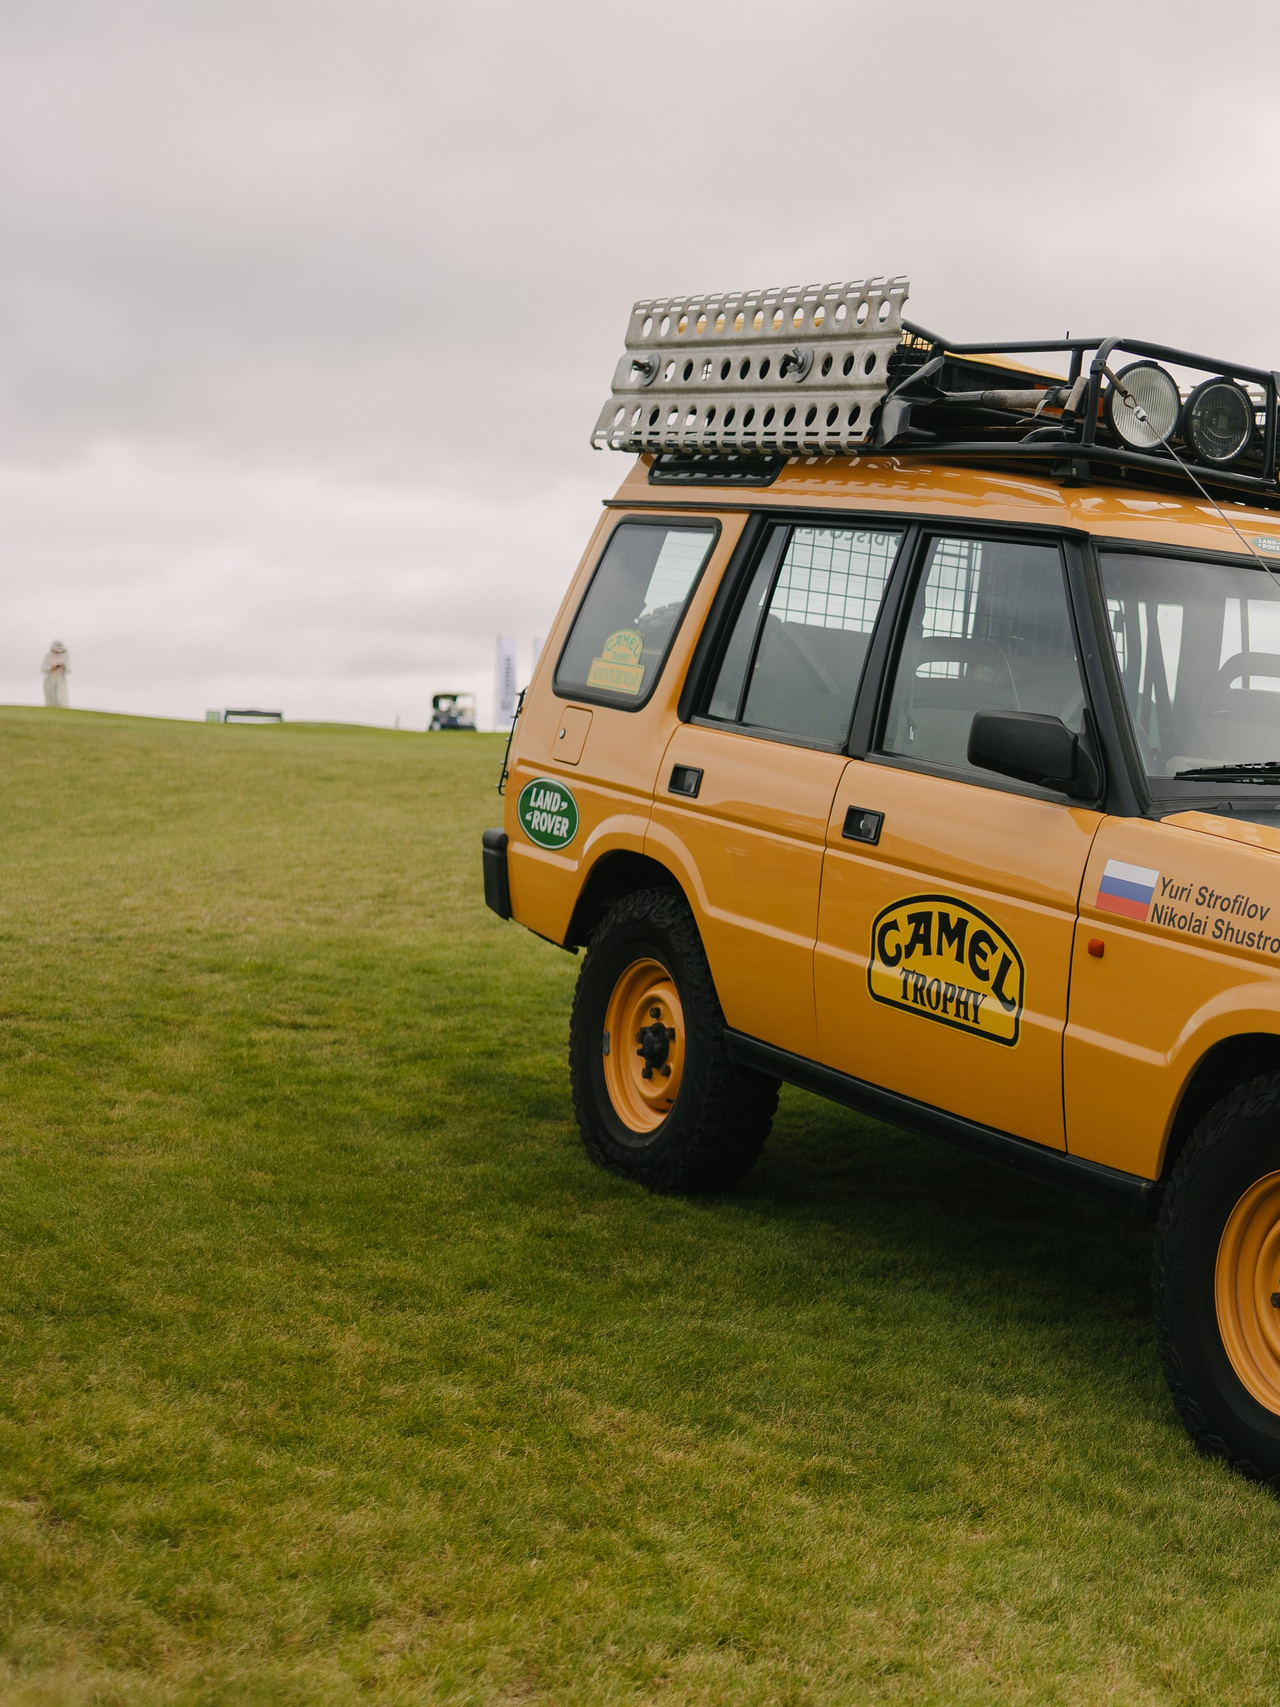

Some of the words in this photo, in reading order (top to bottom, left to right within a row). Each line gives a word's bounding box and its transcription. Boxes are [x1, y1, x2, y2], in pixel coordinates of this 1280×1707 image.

[1258, 537, 1278, 546] LAND
[606, 634, 639, 658] CAMEL
[609, 651, 632, 664] TROPHY
[529, 787, 561, 813] LAND
[531, 809, 569, 838] ROVER
[1160, 876, 1194, 903] Yuri
[1195, 885, 1271, 921] Strofilov
[1150, 903, 1209, 935] Nikolai
[877, 911, 1017, 1012] CAMEL
[900, 966, 987, 1025] TROPHY
